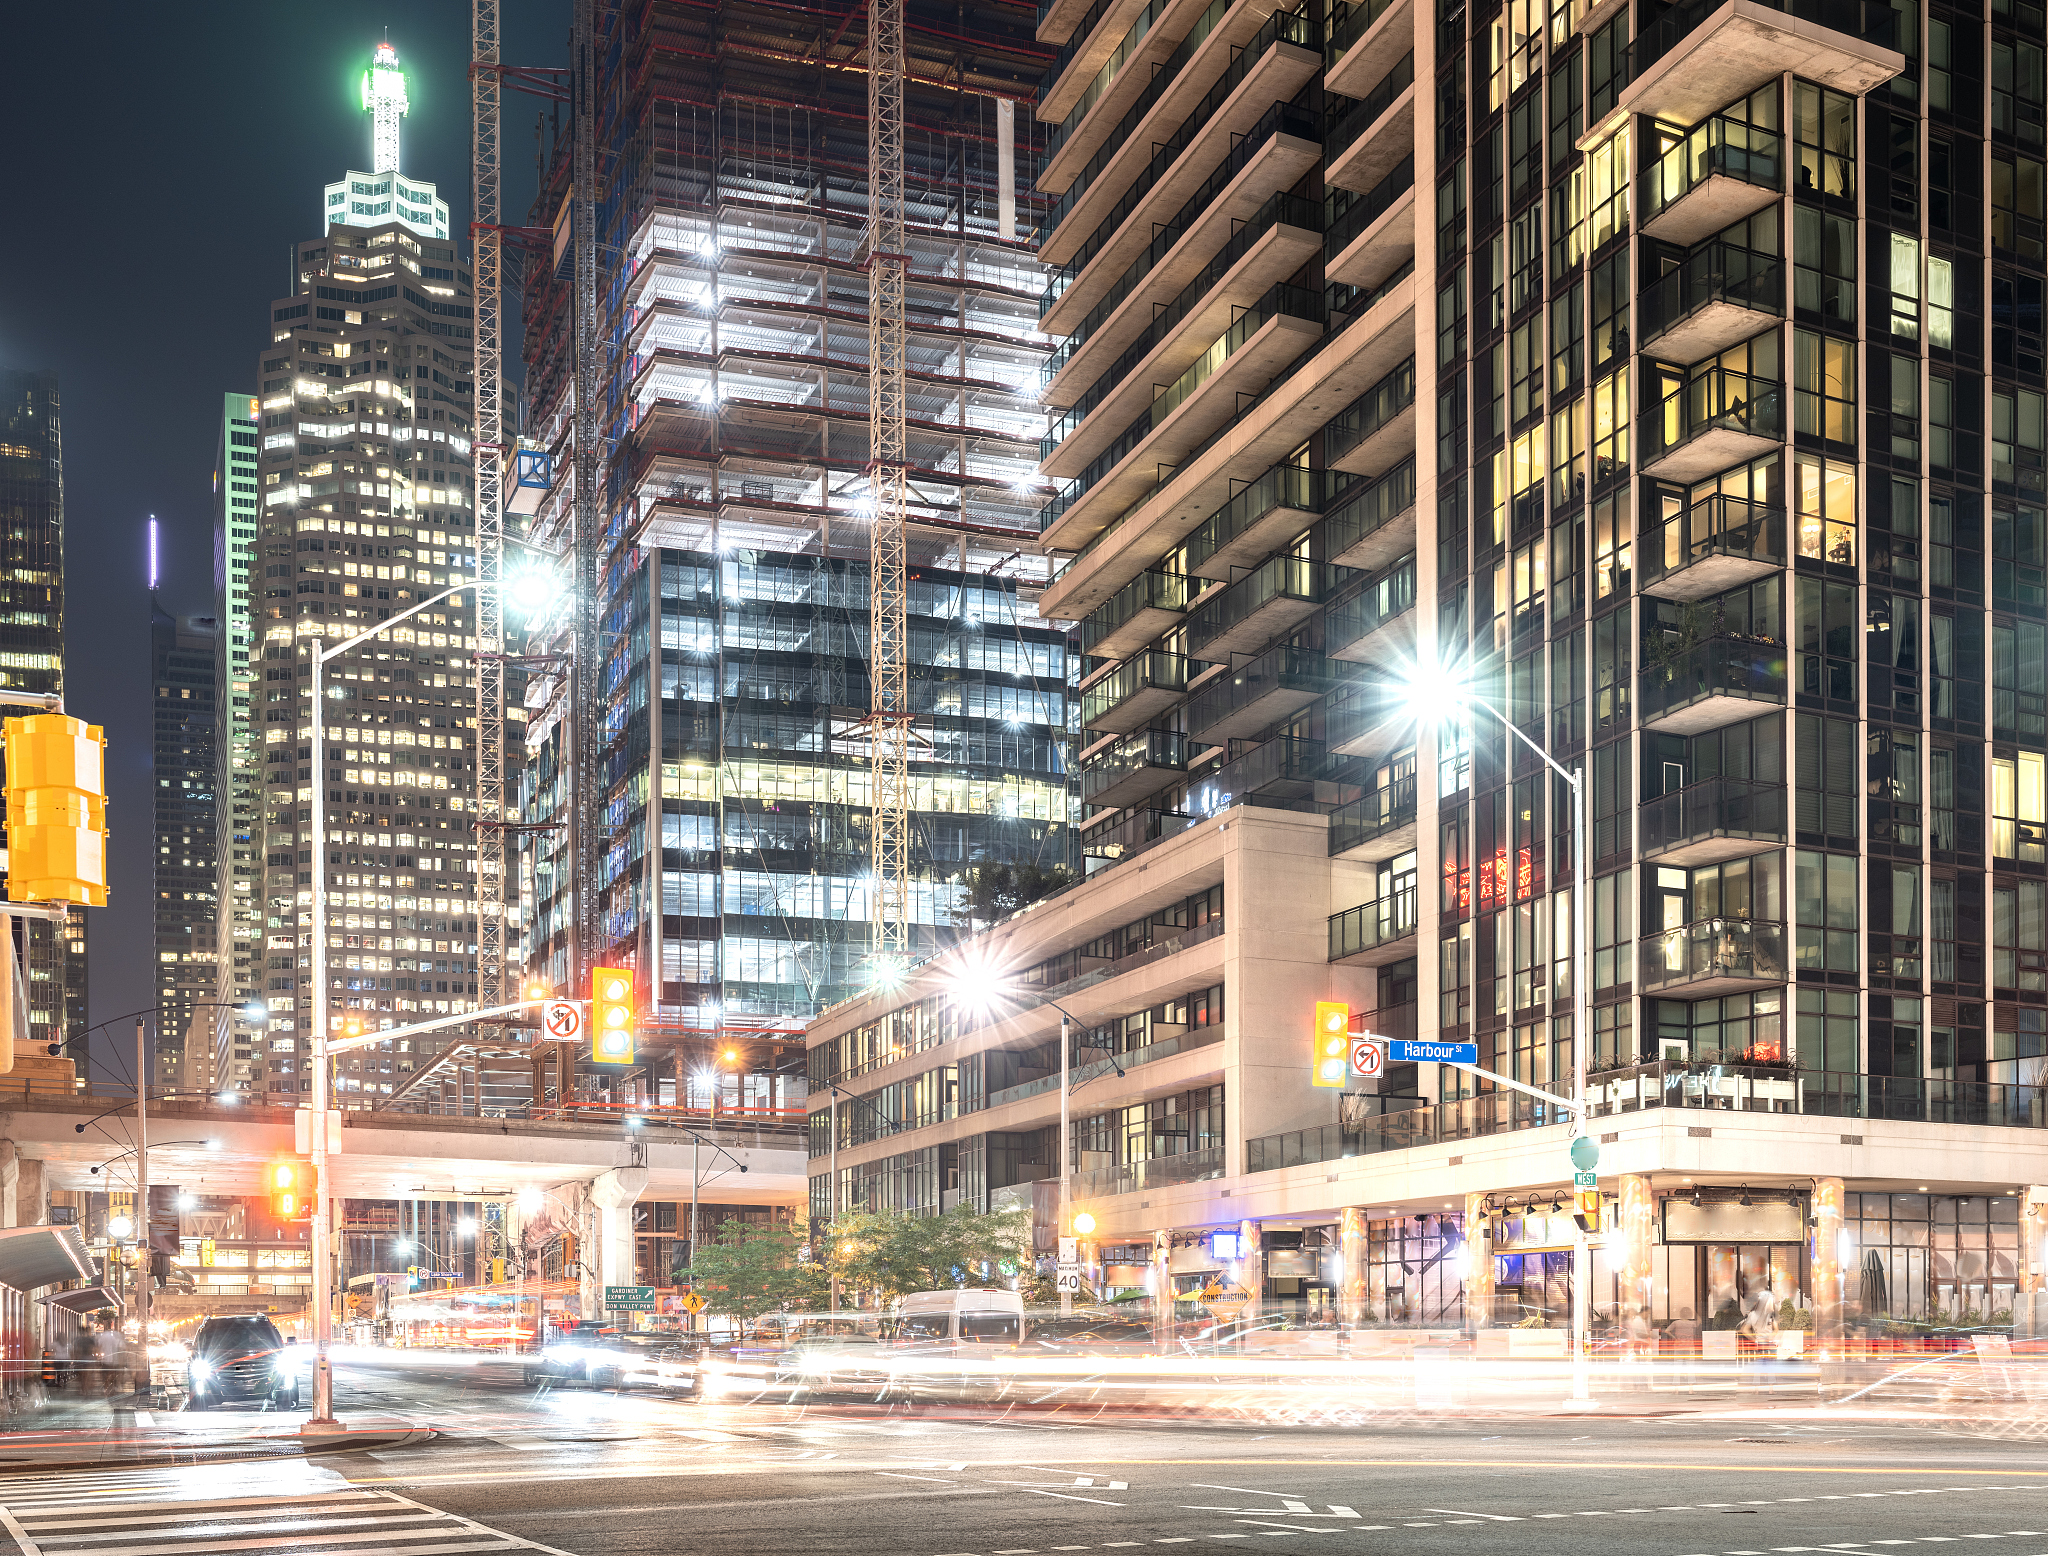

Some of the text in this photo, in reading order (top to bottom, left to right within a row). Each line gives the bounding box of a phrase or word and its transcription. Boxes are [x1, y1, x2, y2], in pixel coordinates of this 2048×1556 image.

[1404, 1042, 1463, 1058] Harbour St
[1577, 1174, 1594, 1185] WEST
[283, 1194, 293, 1213] 8
[1058, 1275, 1078, 1289] 40
[1202, 1292, 1248, 1303] CONSTRUCTION
